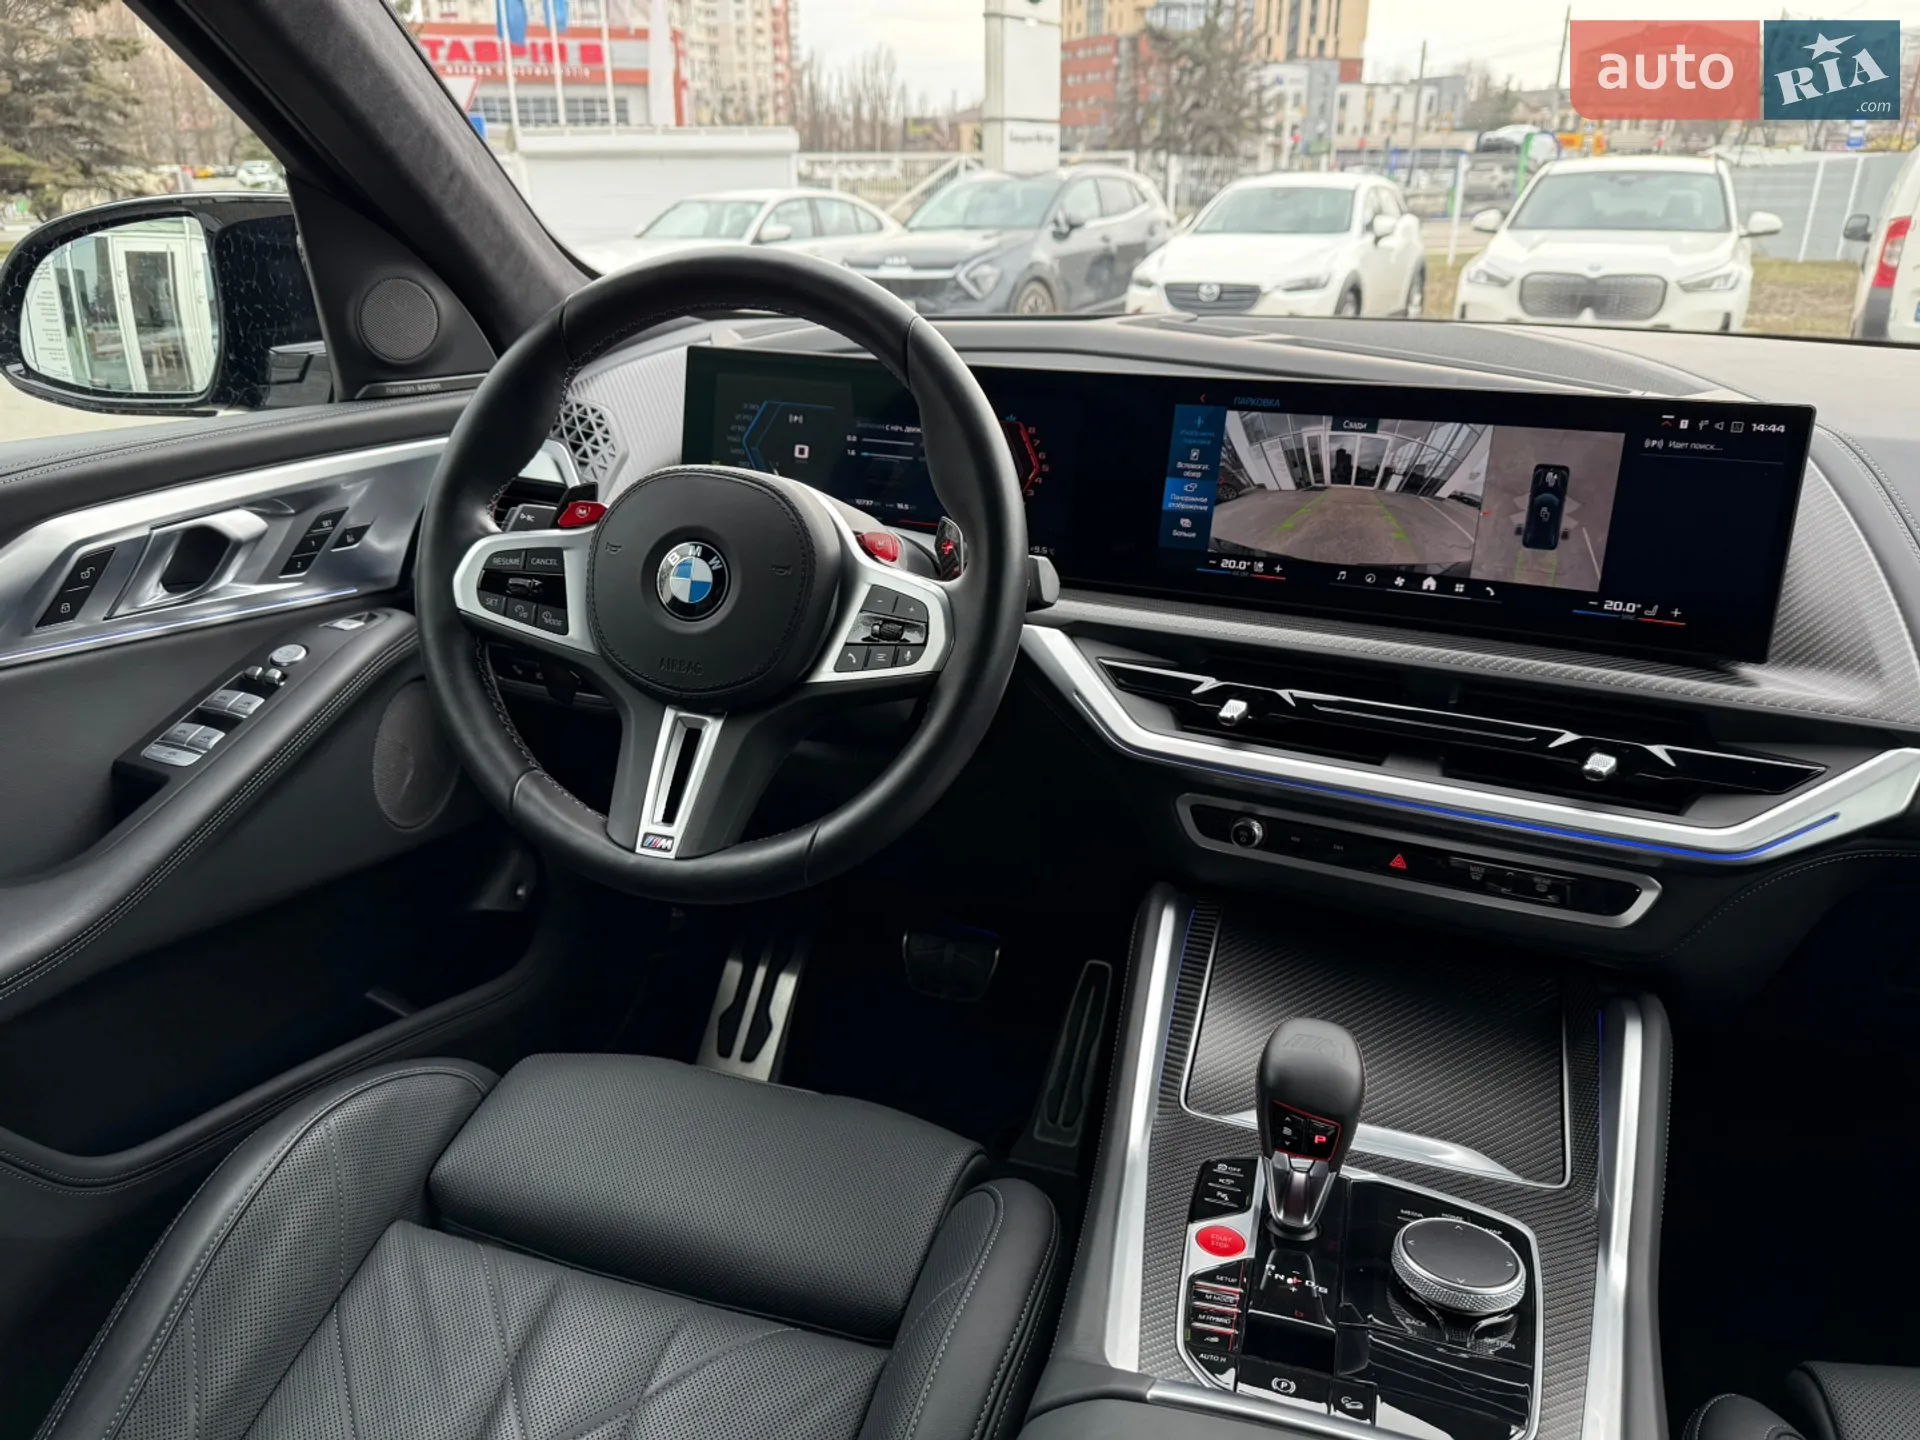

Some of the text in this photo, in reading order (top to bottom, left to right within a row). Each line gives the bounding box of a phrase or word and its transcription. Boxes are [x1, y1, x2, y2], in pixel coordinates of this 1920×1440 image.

[1233, 396, 1280, 408] ПАРКОВКА
[1342, 420, 1367, 431] Сзади
[1751, 423, 1785, 433] 14:44
[1668, 440, 1688, 449] Идет
[492, 558, 558, 566] RESUME CANCEL
[668, 545, 723, 571] BMW
[485, 597, 499, 607] SET
[658, 657, 703, 676] AIRBAG
[1314, 1134, 1327, 1144] P
[1210, 1233, 1233, 1243] START
[1210, 1240, 1230, 1249] STOP
[1215, 1274, 1238, 1283] SETUP
[1274, 1273, 1285, 1281] N
[1405, 1317, 1427, 1328] BACK
[1199, 1353, 1220, 1362] AUTO
